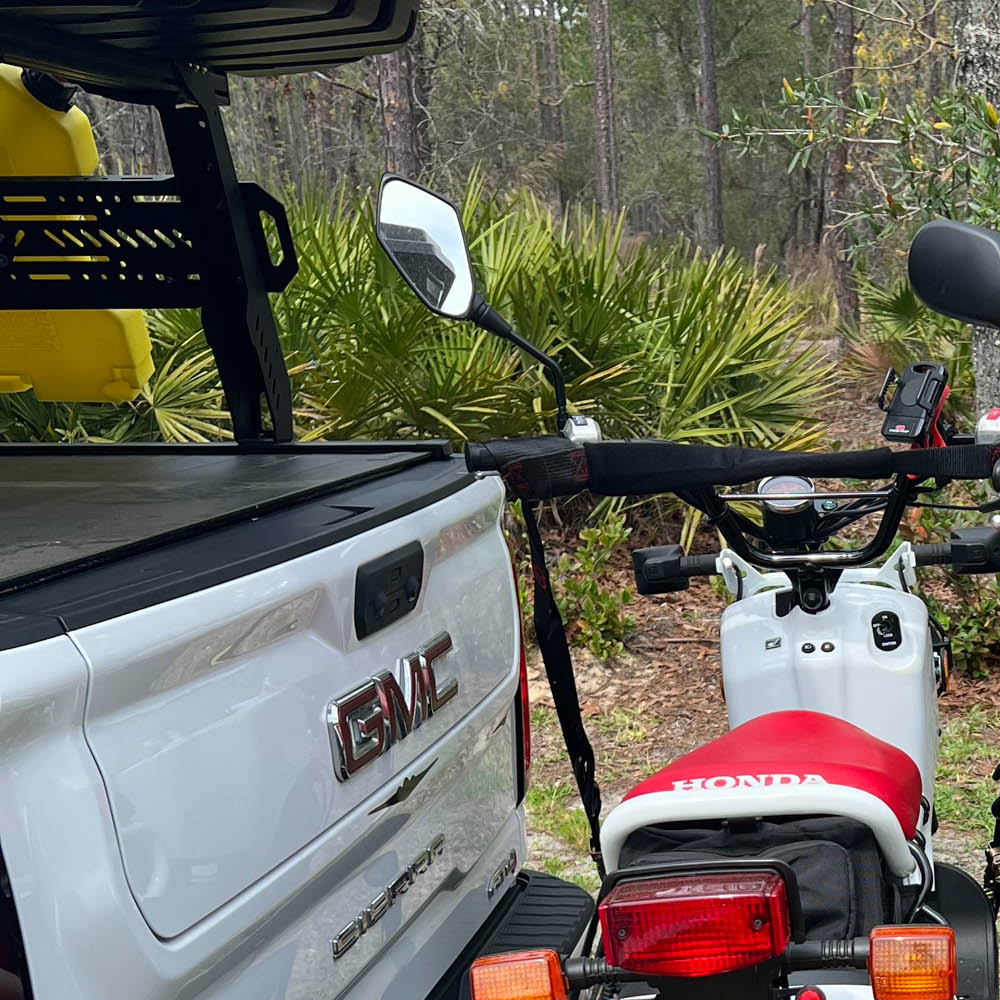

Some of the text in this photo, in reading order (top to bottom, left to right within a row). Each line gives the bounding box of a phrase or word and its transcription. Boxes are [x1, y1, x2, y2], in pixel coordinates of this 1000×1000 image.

[327, 631, 459, 783] GMC
[672, 774, 828, 792] HONDA
[330, 834, 445, 959] SIERRA
